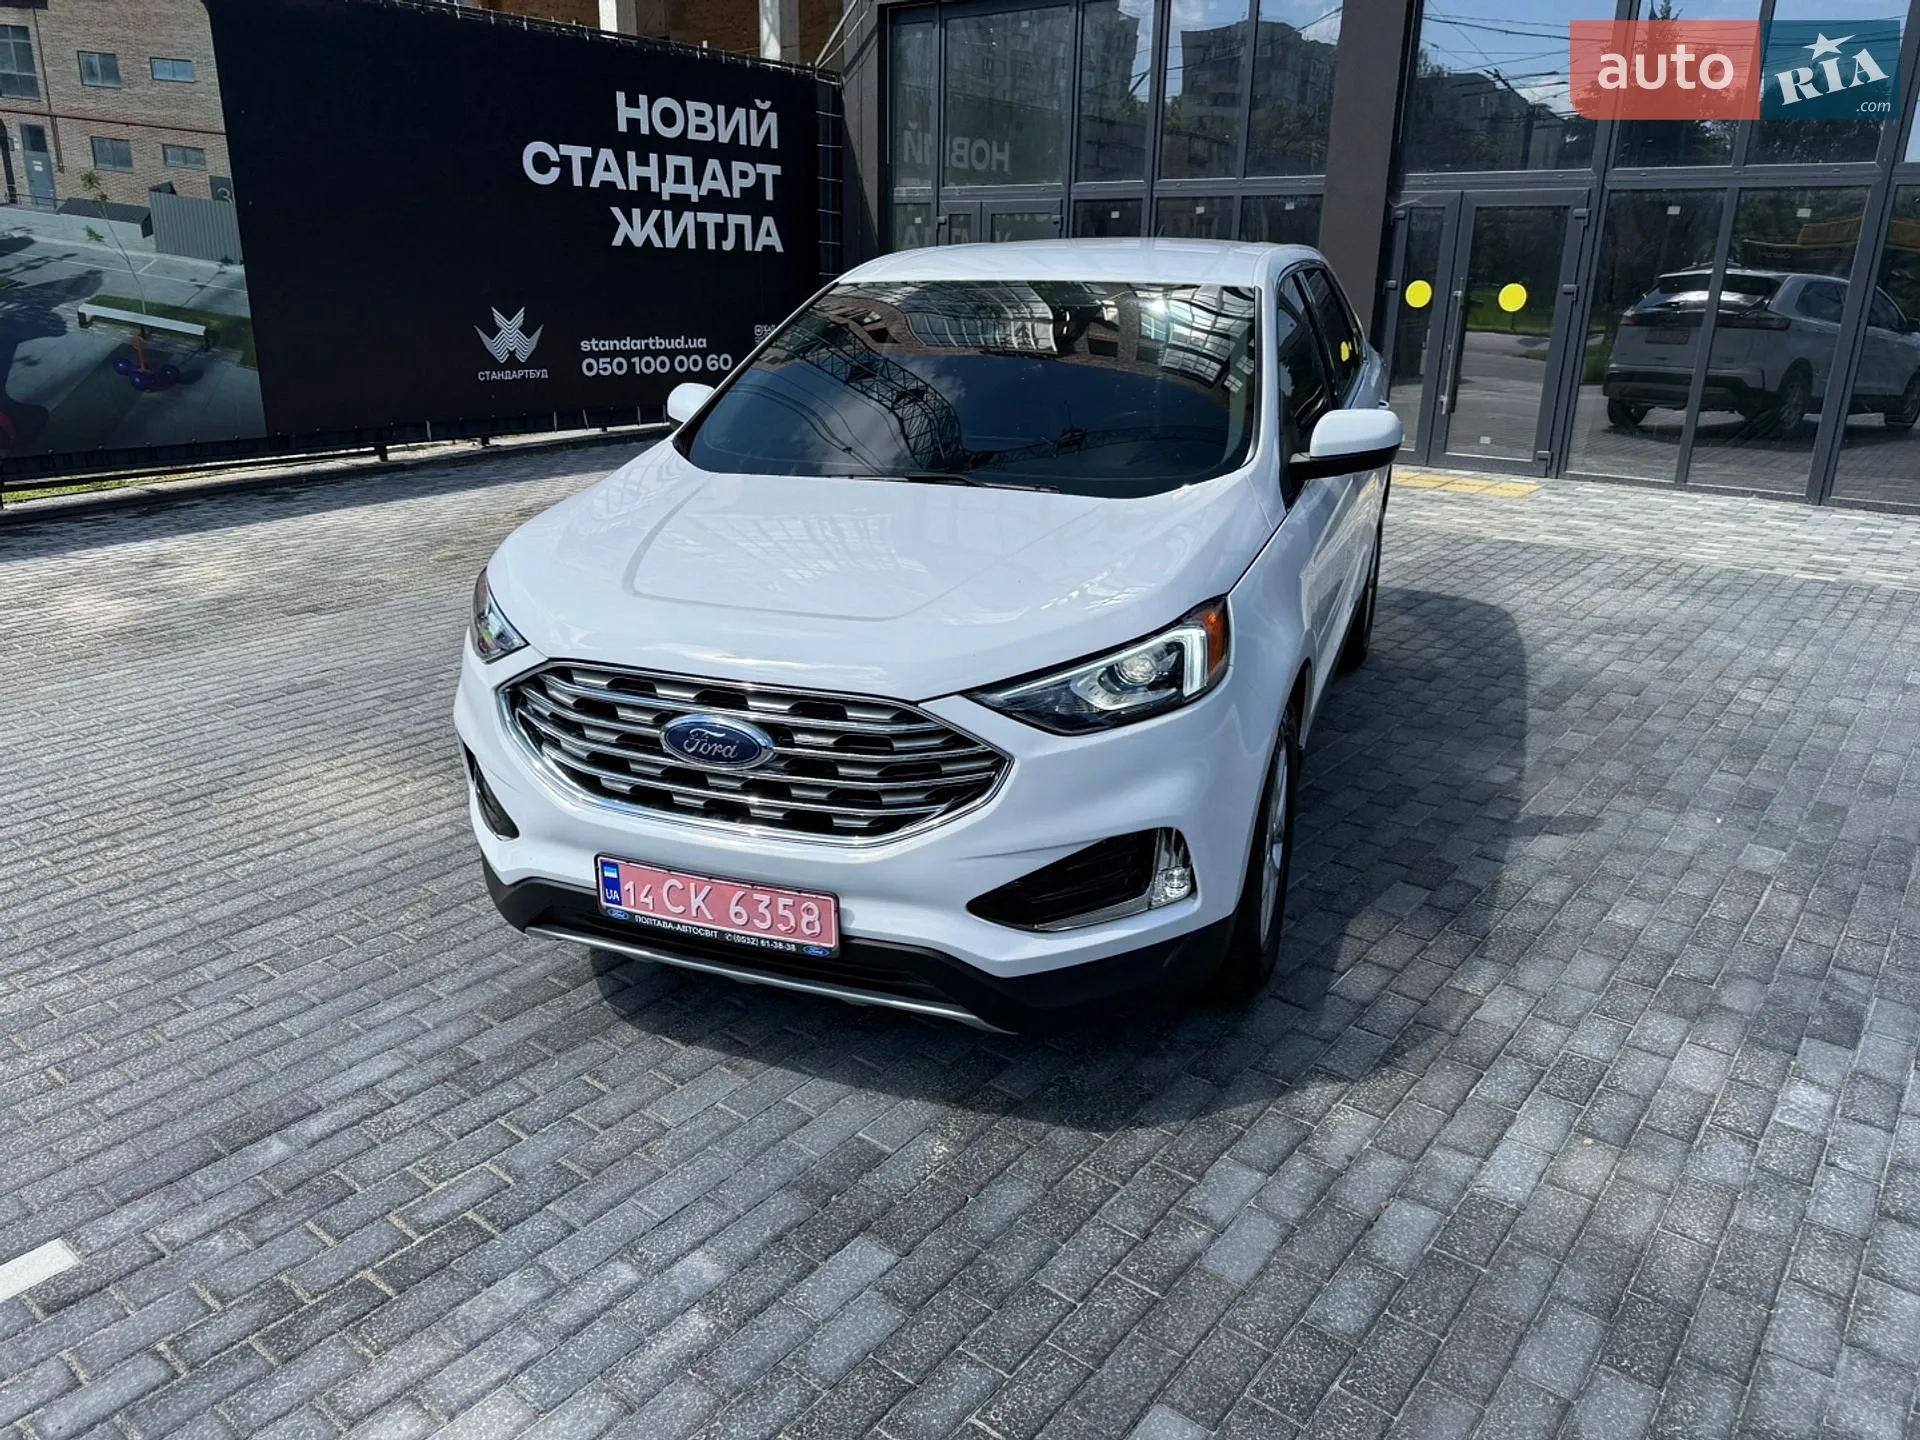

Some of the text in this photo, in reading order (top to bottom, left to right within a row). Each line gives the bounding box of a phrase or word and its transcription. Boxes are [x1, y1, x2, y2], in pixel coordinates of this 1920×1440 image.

[615, 91, 779, 149] НОВИЙ
[522, 141, 782, 202] СТАНДАРТ
[609, 206, 784, 253] ЖИТЛА
[580, 335, 707, 352] standartbud.ua
[477, 368, 549, 381] СТАНДАРТБУД
[581, 353, 733, 377] 050 100 00 60
[682, 727, 741, 759] Ford
[605, 888, 620, 902] UA
[729, 890, 822, 938] 6358
